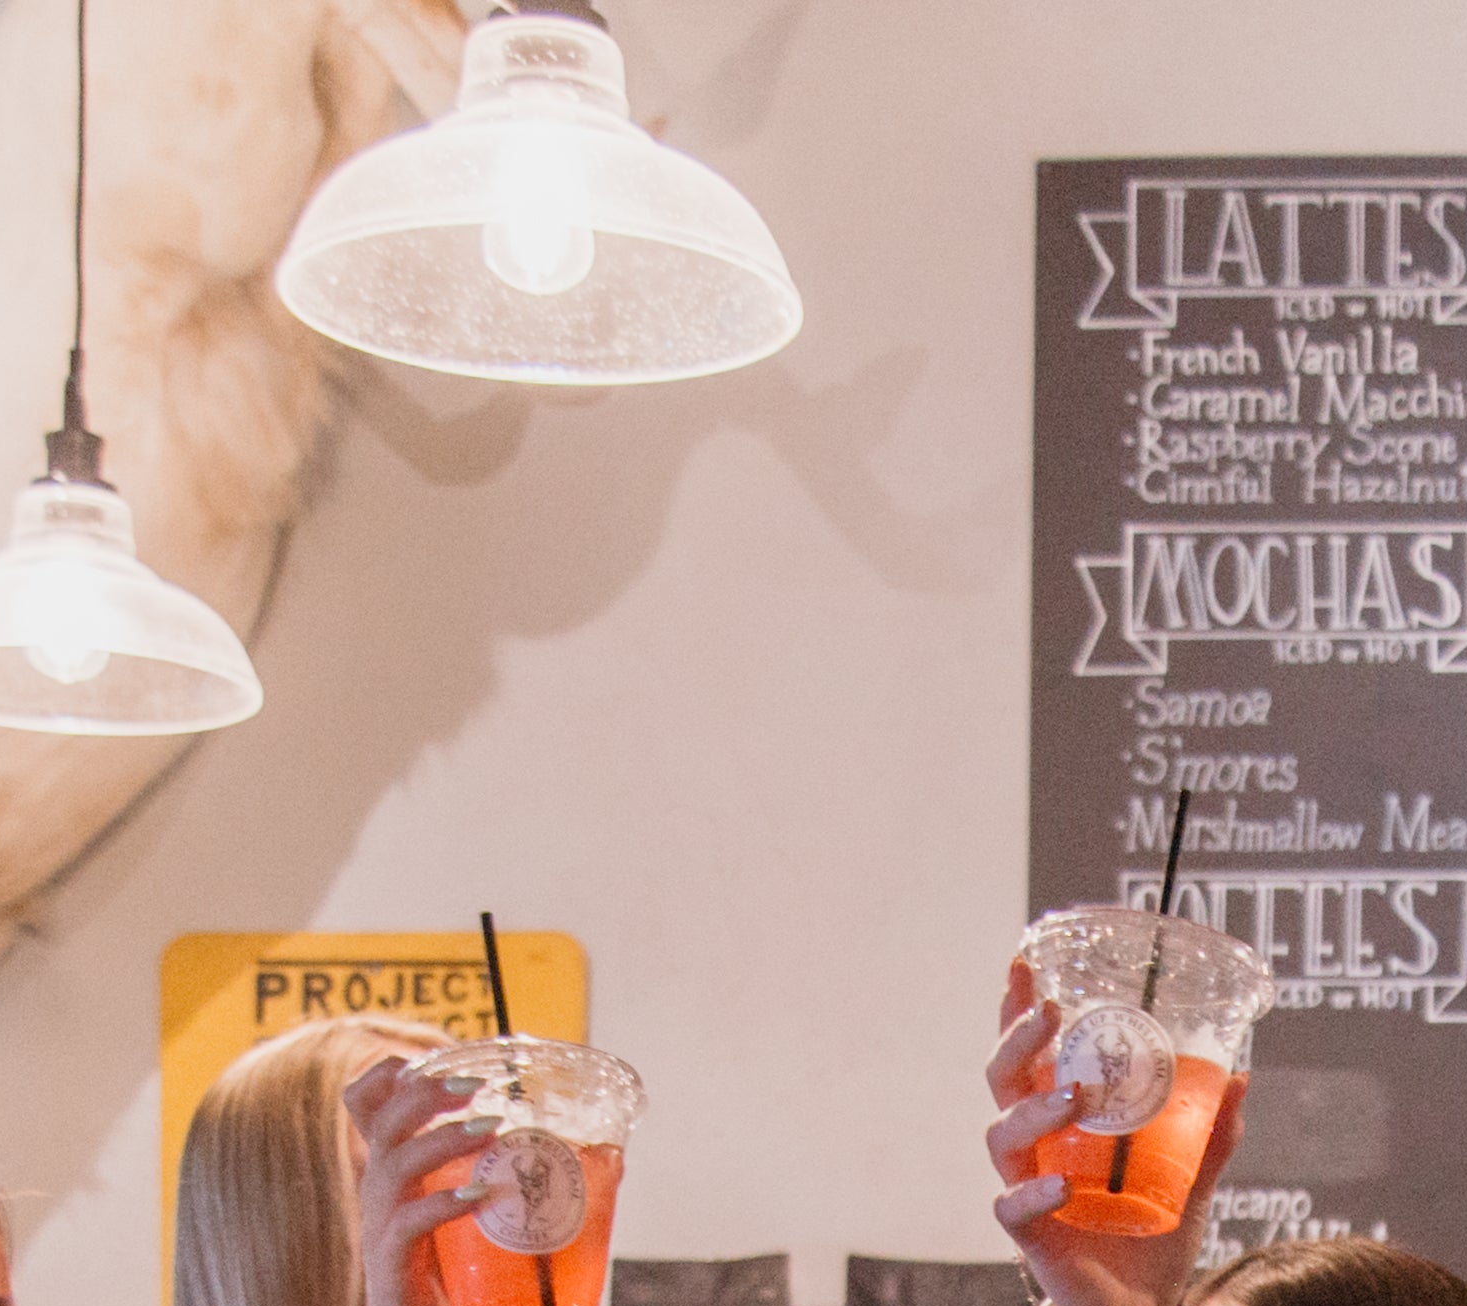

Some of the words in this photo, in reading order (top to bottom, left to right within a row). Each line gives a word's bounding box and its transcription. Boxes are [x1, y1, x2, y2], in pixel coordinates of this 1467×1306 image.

[1164, 187, 1465, 288] LATTES
[1142, 330, 1260, 375] French
[1279, 326, 1420, 374] Vanilla
[1143, 373, 1301, 423] Caramel
[1139, 418, 1330, 471] Raspberry
[1344, 420, 1458, 465] Scone
[1134, 534, 1462, 631] MOCHAS
[1137, 679, 1273, 728] Samoa
[1134, 733, 1300, 793] S'mores
[1275, 985, 1323, 1009] CED
